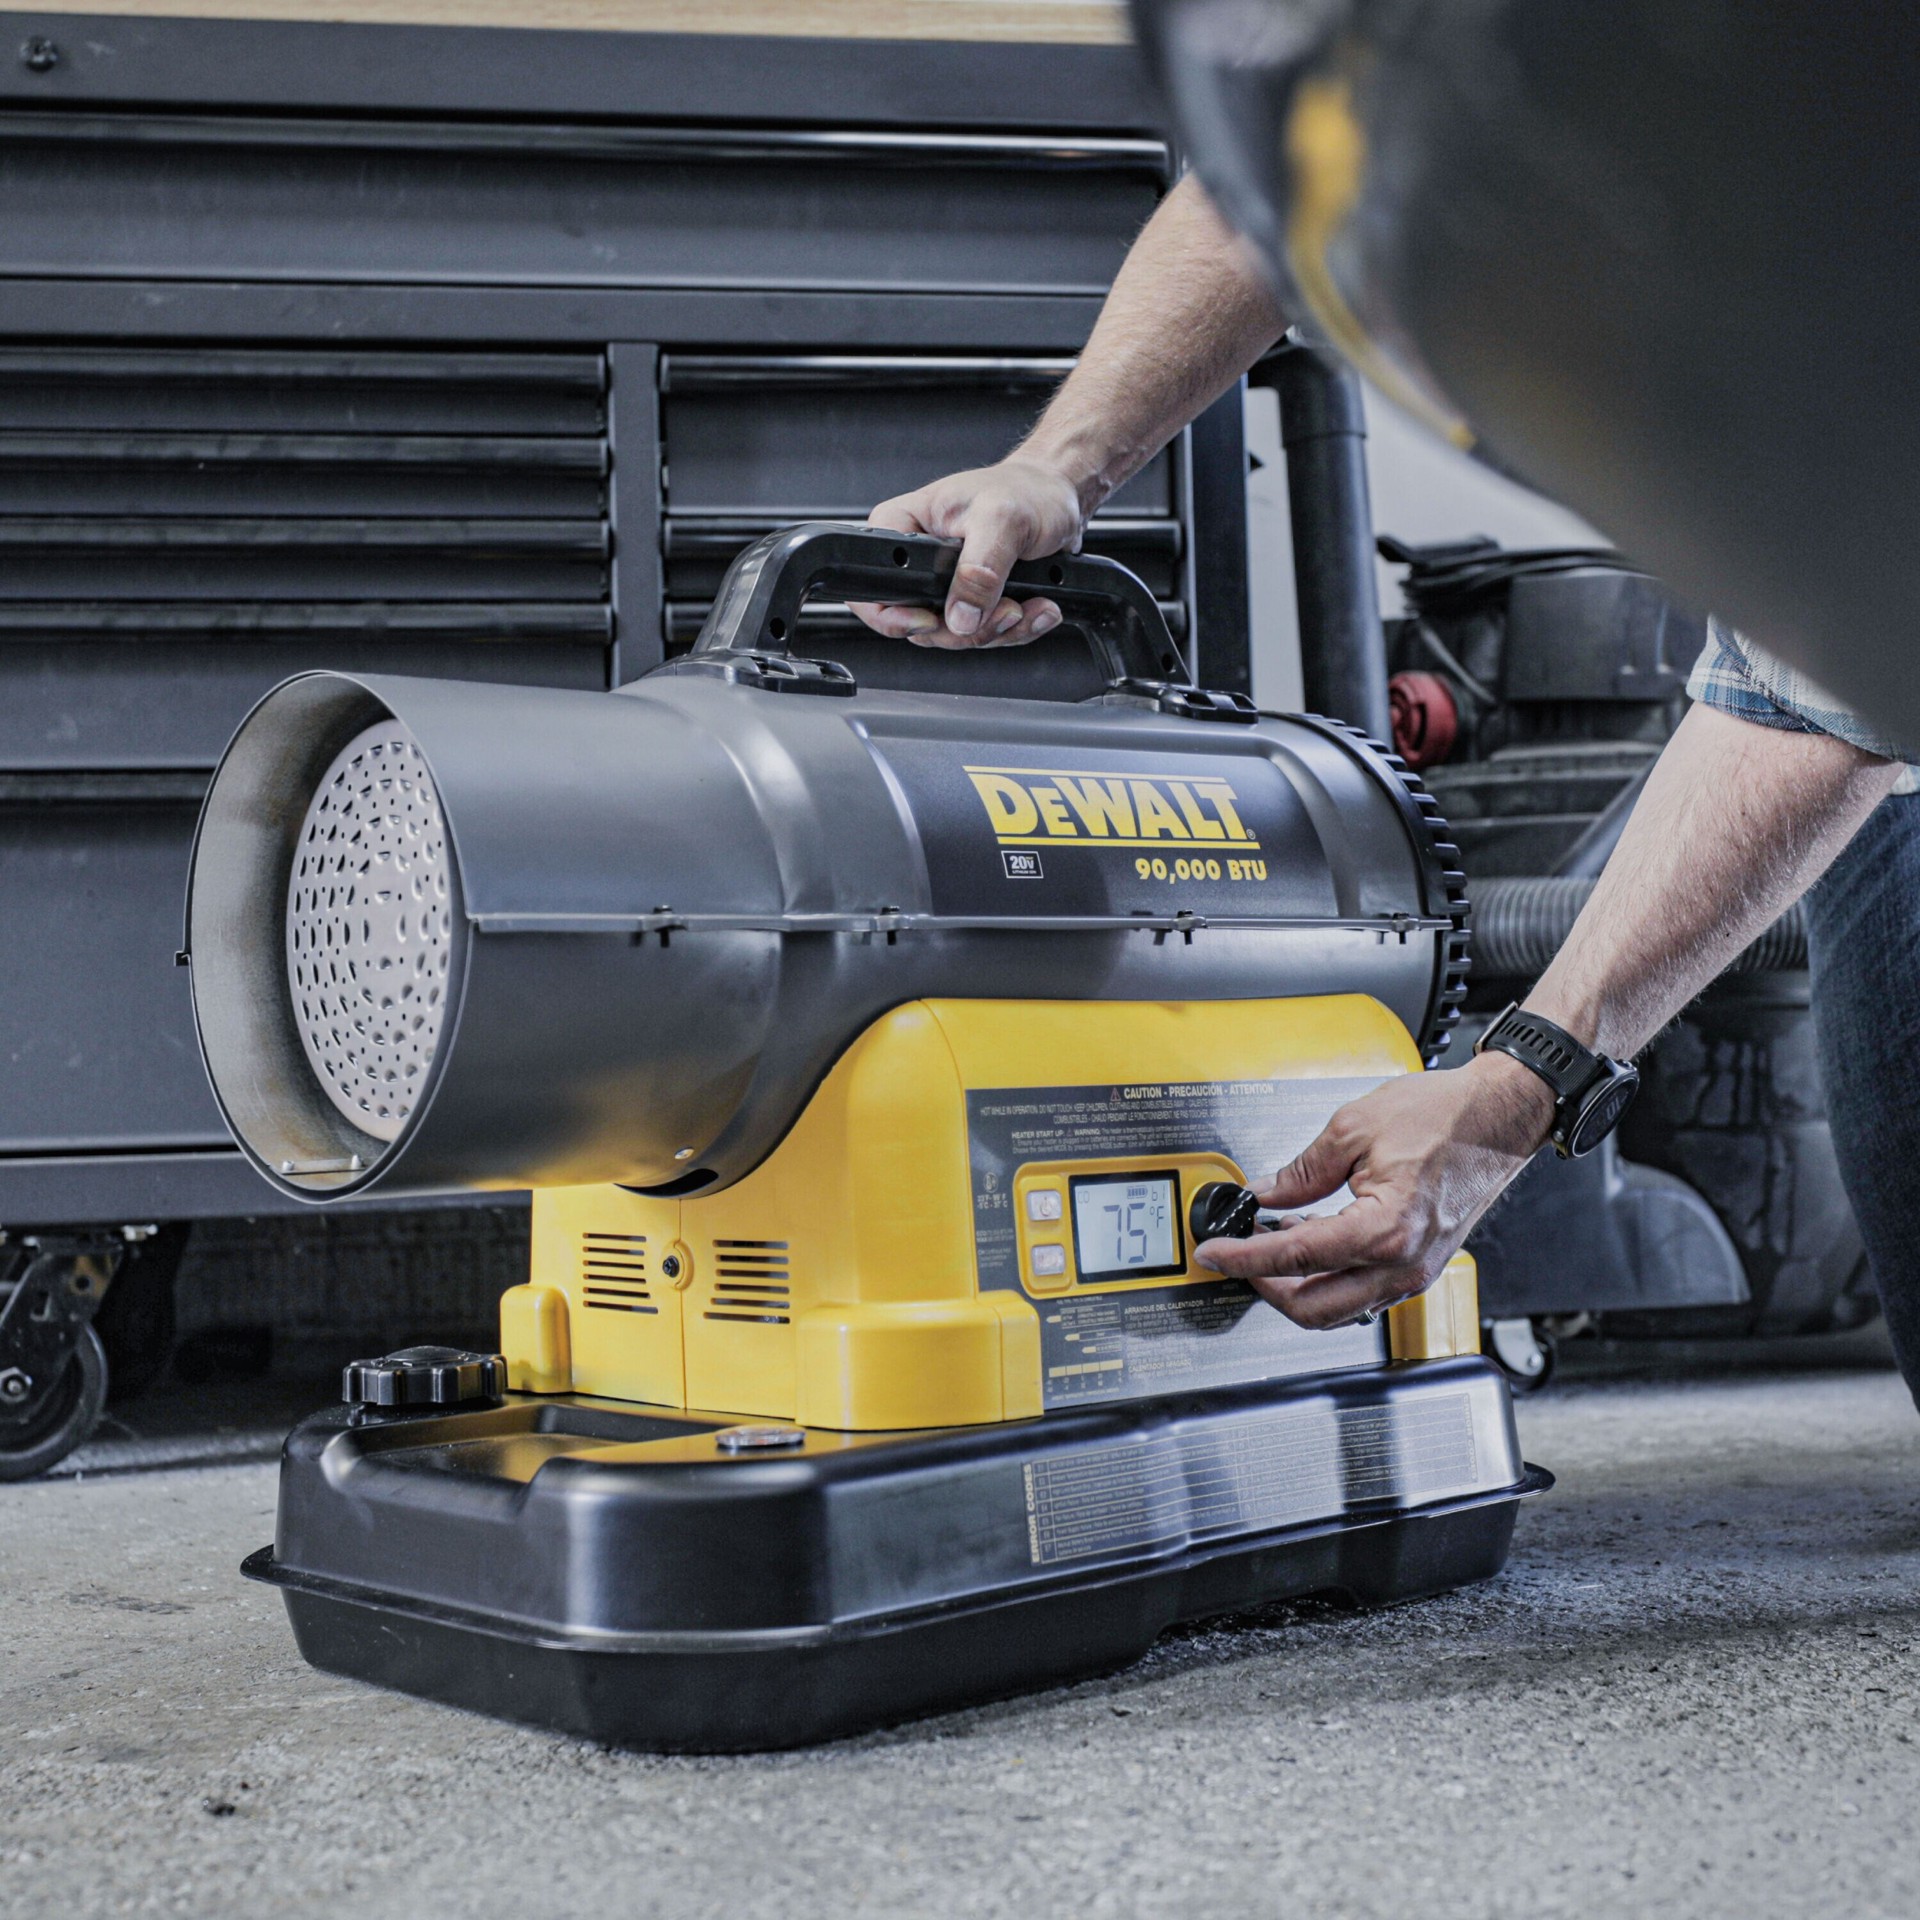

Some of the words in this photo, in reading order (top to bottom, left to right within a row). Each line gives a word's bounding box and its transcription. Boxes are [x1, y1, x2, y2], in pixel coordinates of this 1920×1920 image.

[1135, 858, 1221, 884] 90,000
[1226, 860, 1267, 881] BTU
[1124, 1087, 1162, 1099] CAUTION
[1169, 1084, 1224, 1097] PRECAUCIÓN
[1230, 1083, 1274, 1096] ATTENTION
[1102, 1202, 1147, 1263] 75
[1024, 1464, 1035, 1511] CODES
[1028, 1514, 1040, 1562] ERROR
